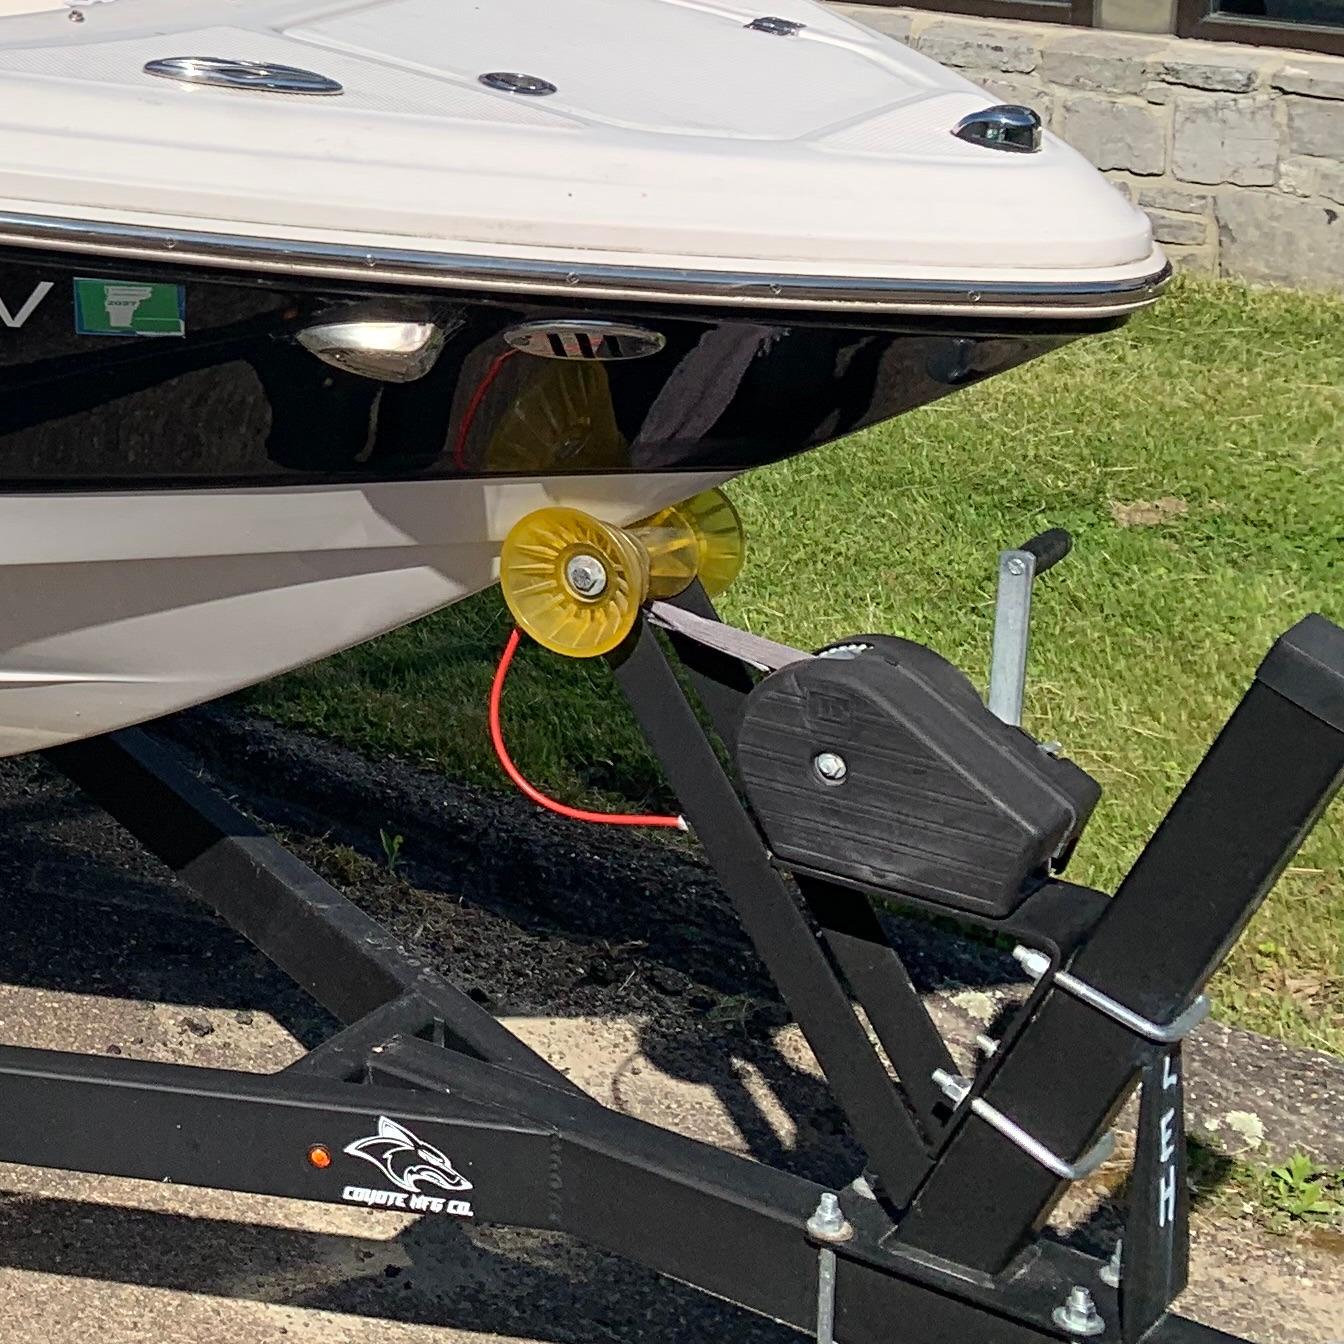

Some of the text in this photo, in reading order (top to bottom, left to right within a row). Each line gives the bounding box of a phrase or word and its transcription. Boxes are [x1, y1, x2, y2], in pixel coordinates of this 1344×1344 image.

[342, 1186, 474, 1217] COYOTE MFG CO.
